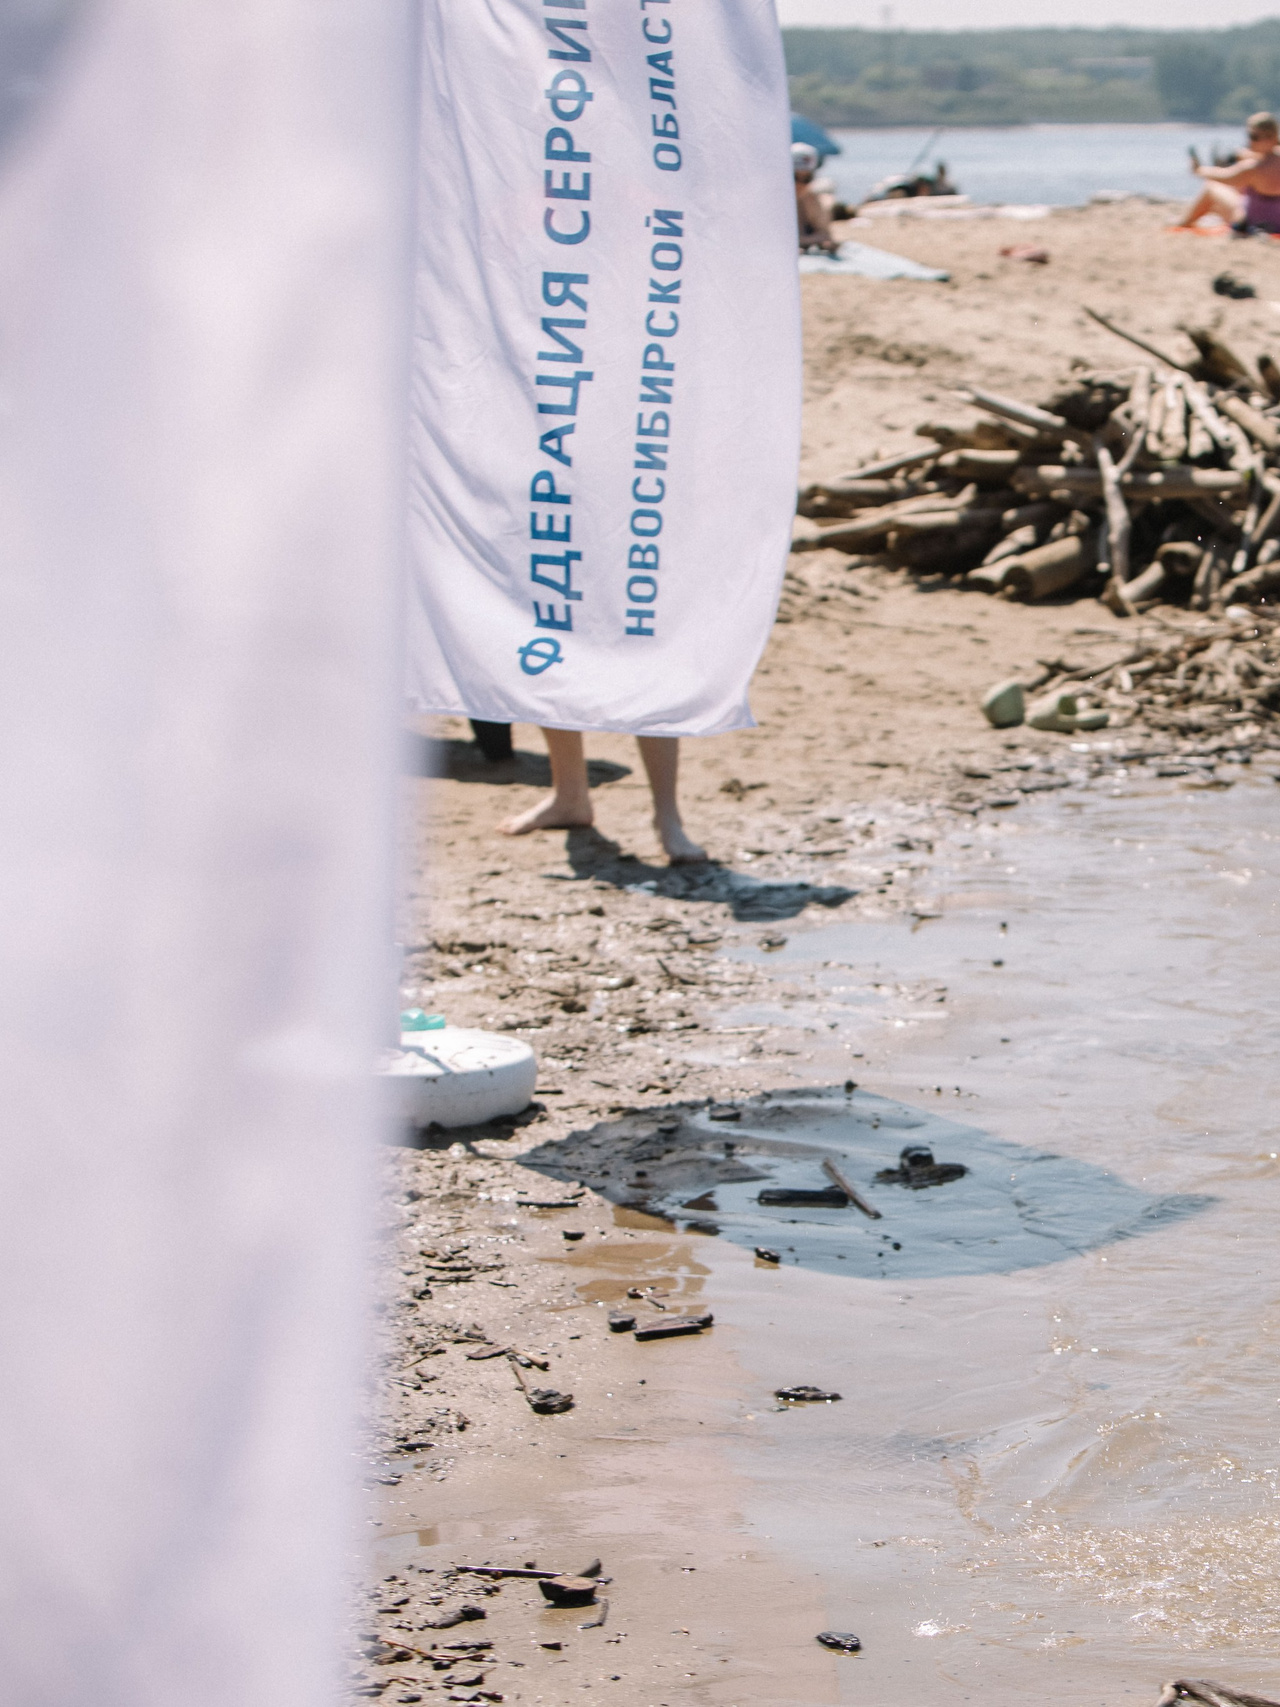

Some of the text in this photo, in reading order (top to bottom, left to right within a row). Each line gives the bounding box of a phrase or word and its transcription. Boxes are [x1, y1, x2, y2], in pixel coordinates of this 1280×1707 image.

[516, 0, 594, 676] ФЕДЕРАЦИЯ СЕРФИ
[625, 209, 684, 636] НОВОСИБИРСКОЙ
